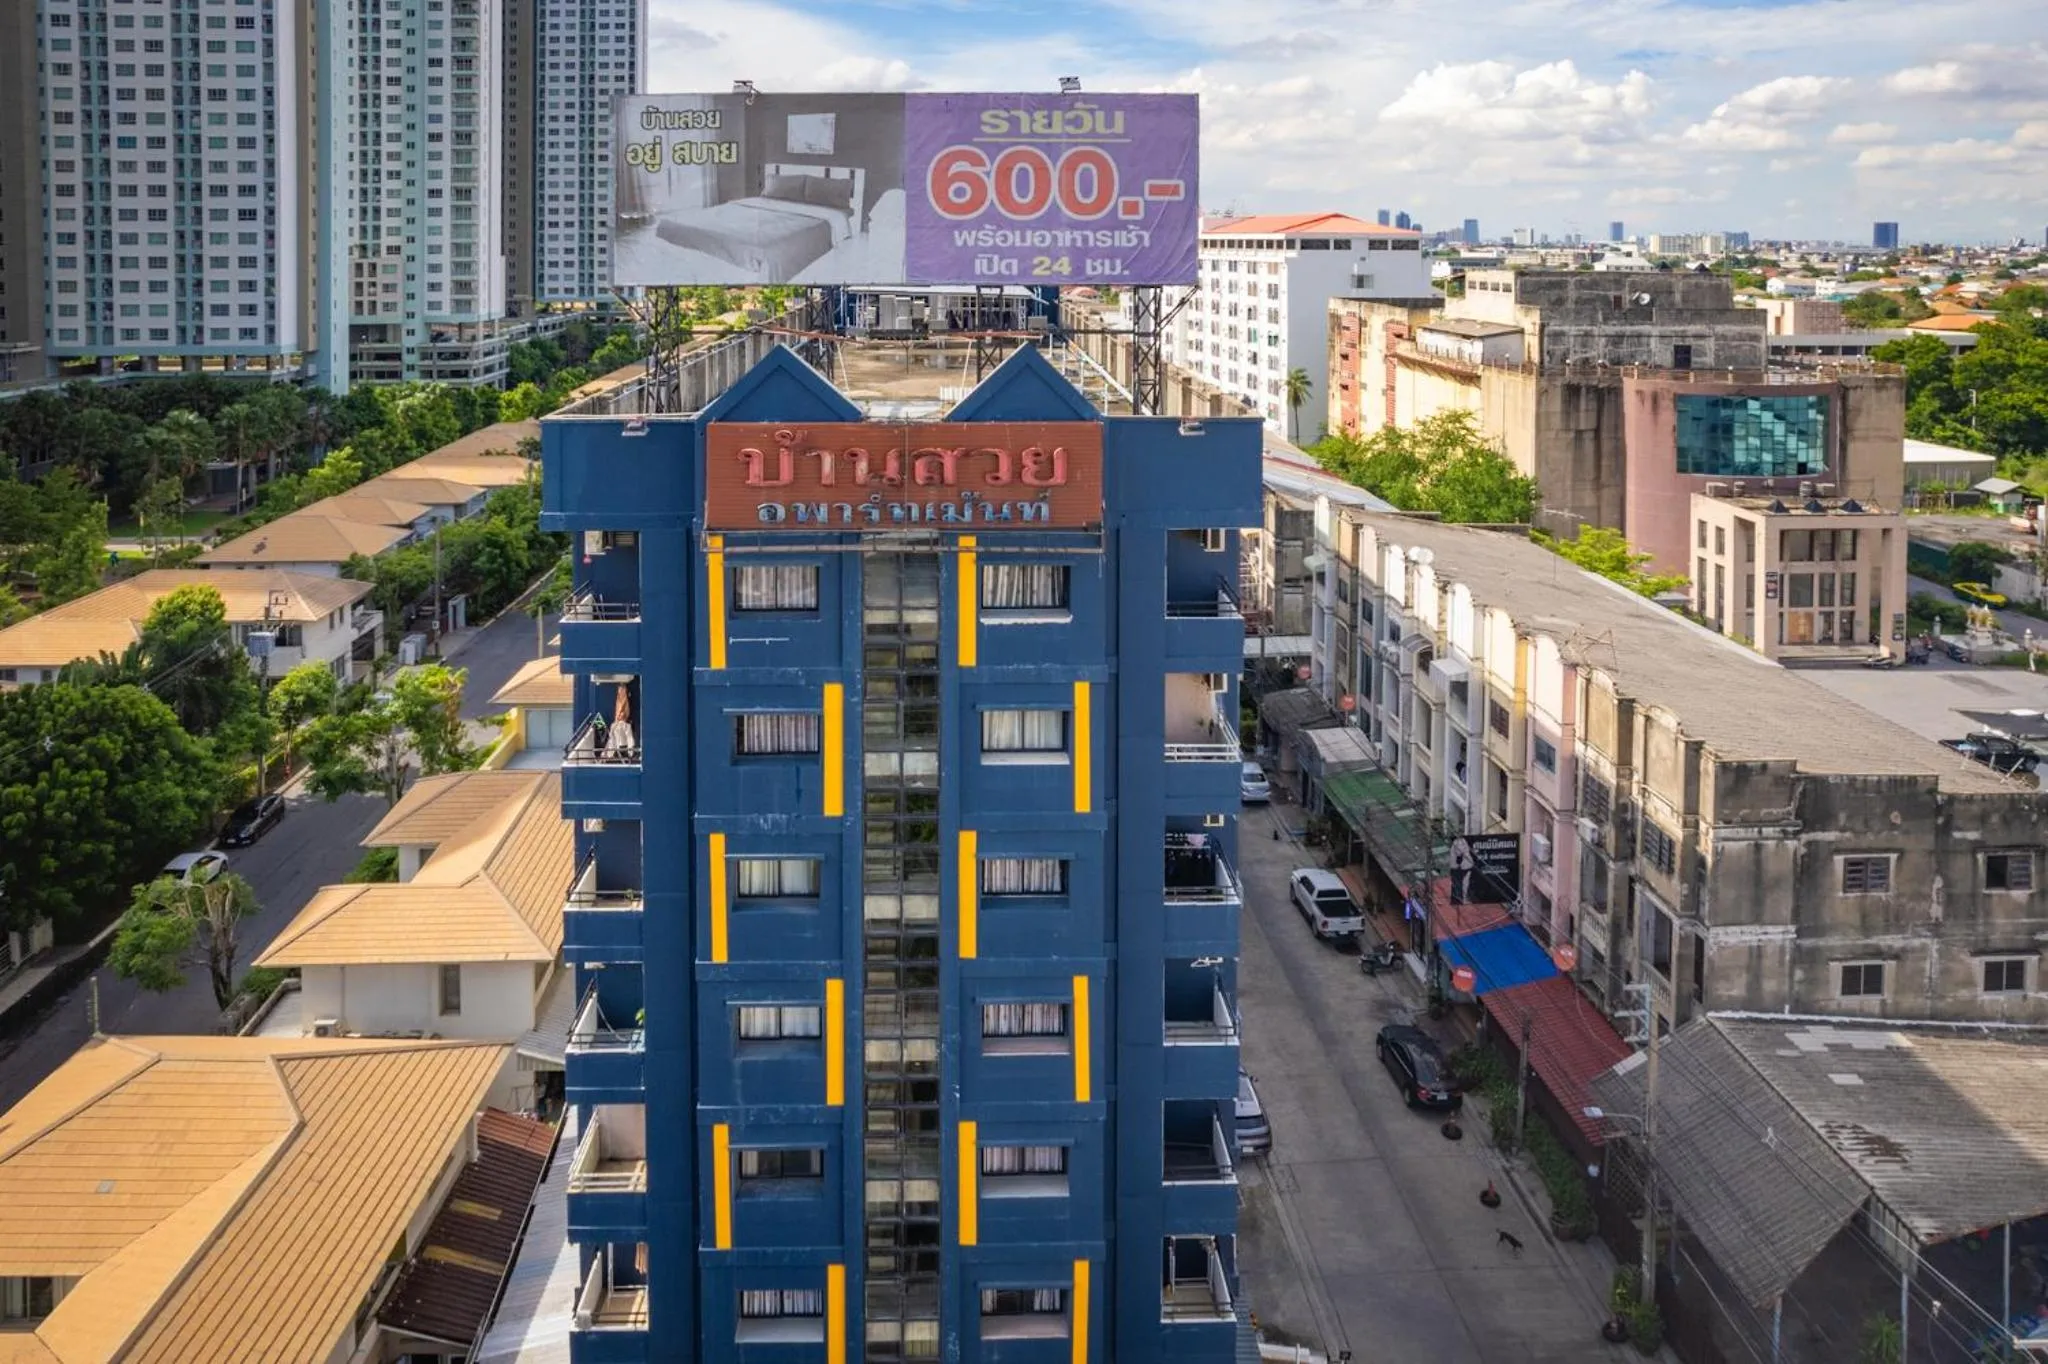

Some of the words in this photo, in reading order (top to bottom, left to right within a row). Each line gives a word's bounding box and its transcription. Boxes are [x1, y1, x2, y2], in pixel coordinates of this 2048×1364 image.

[641, 105, 722, 130] บ้านสวย
[980, 102, 1126, 134] รายวัน
[625, 137, 662, 173] อยู่
[673, 141, 739, 164] สบาย
[926, 145, 1185, 221] 600.-
[953, 224, 1151, 248] พร้อมอาหารเช้า
[974, 254, 1018, 276] เปิด
[1032, 256, 1072, 276] 24
[1085, 258, 1131, 276] ชม.
[736, 428, 1069, 487] บ้านสวย
